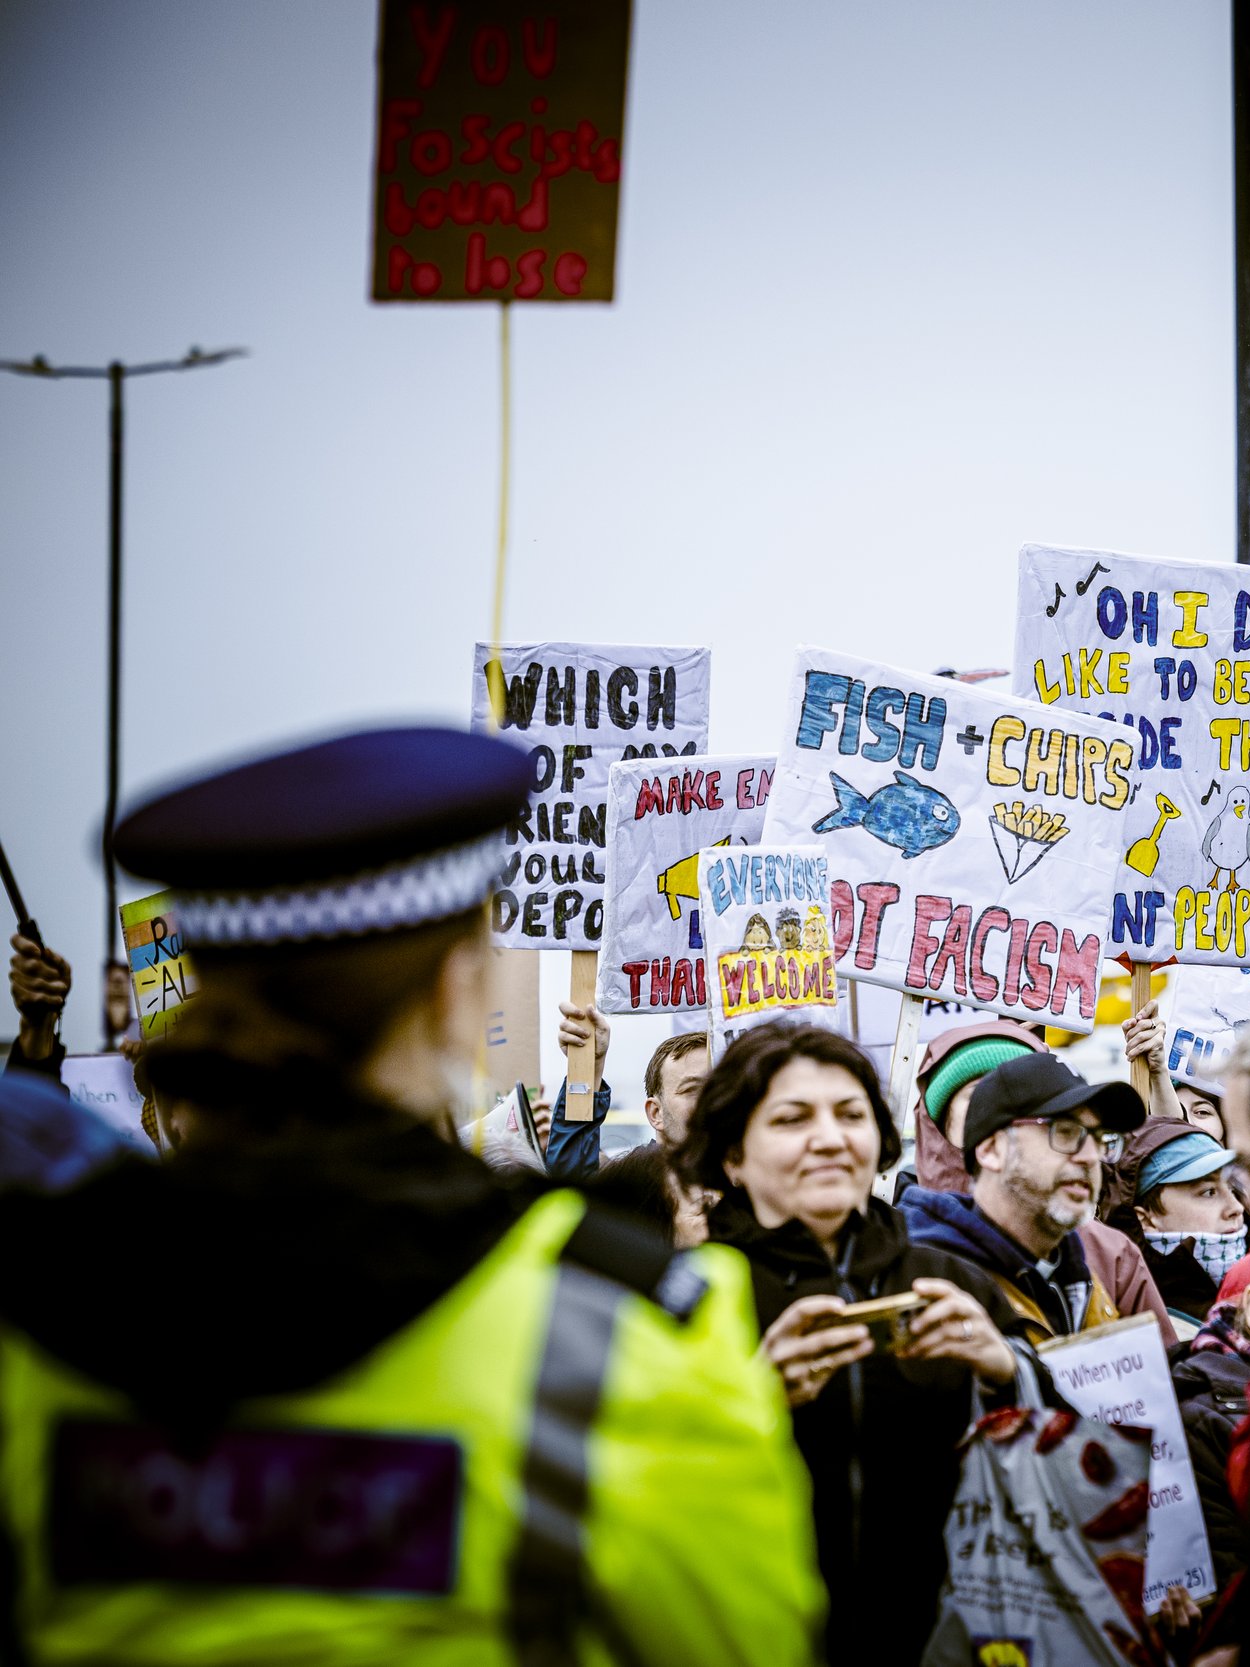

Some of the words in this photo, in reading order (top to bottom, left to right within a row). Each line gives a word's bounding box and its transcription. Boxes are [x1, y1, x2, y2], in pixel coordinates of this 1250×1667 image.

[1096, 586, 1159, 646] OH
[1172, 591, 1209, 649] I
[483, 660, 677, 731] WHICH
[1034, 648, 1130, 705] LIKE
[1154, 657, 1197, 701] TO
[796, 669, 948, 772] FISH
[986, 715, 1134, 811] CHIPS
[527, 745, 592, 793] OF
[634, 769, 724, 821] MAKE
[505, 800, 607, 848] RIEN
[707, 854, 829, 917] EVERYONE
[491, 890, 605, 941] DEPO
[831, 879, 901, 970] OT
[904, 895, 1100, 1019] FACISM
[722, 955, 834, 1008] WELCOME
[1111, 1353, 1144, 1381] you
